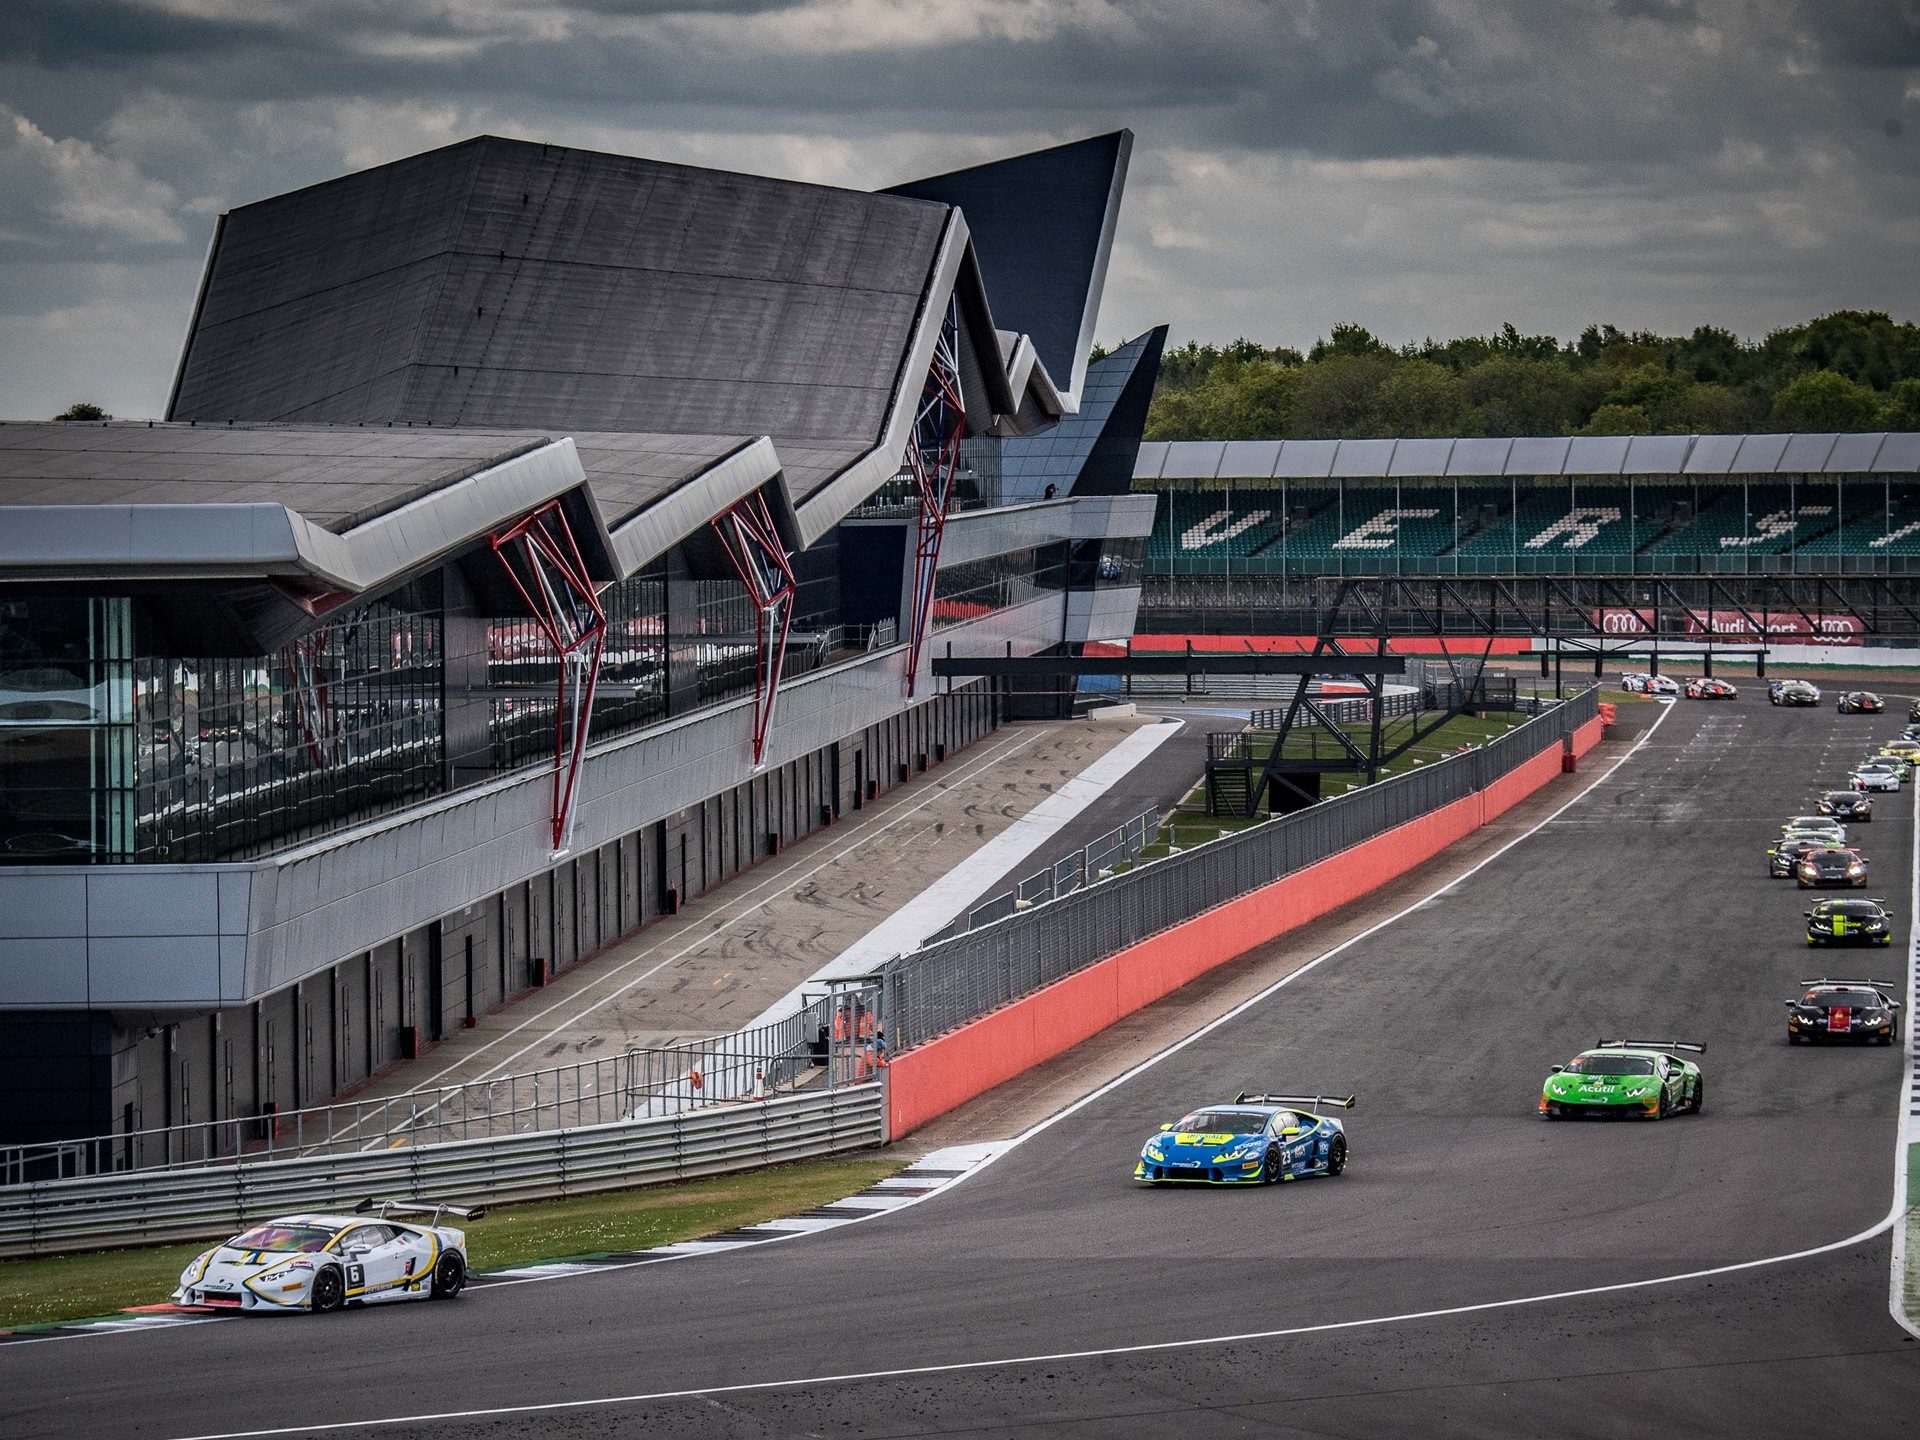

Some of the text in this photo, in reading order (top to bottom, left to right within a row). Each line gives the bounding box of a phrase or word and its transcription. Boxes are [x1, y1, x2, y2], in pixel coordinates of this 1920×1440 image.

[1711, 617, 1744, 633] Audi
[1578, 1085, 1615, 1093] Acutil
[1281, 1150, 1291, 1165] 23
[350, 1266, 359, 1282] 6
